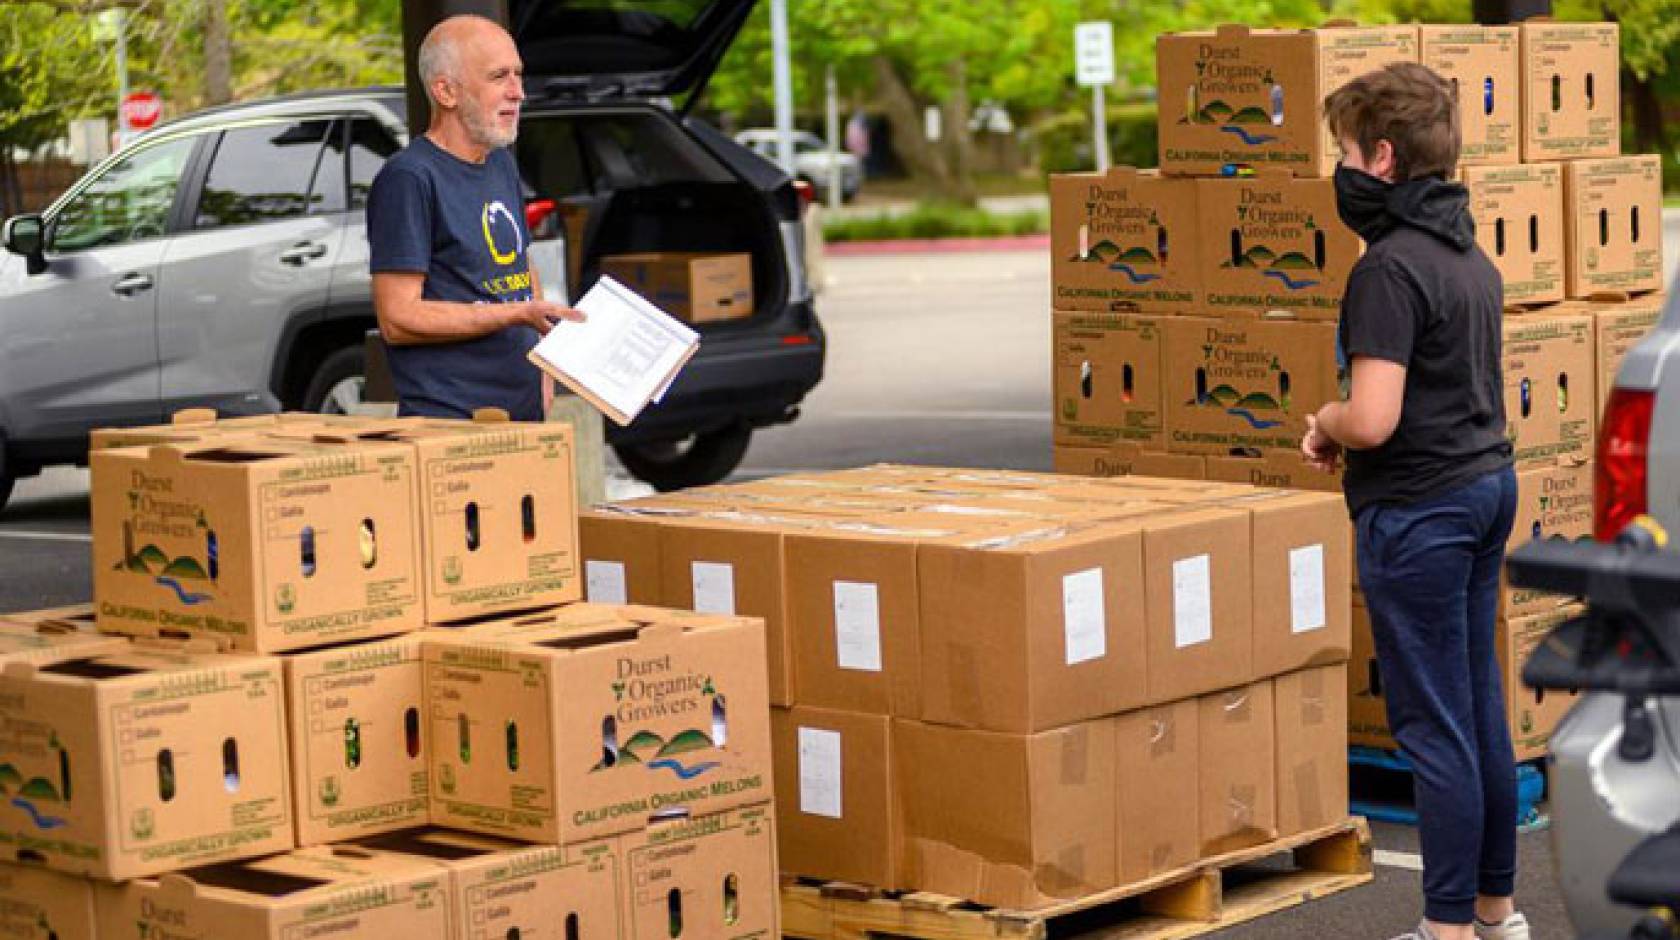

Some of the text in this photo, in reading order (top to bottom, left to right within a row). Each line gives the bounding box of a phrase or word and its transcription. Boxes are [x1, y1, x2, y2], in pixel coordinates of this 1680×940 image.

[1200, 43, 1240, 60] Durst
[1207, 60, 1262, 80] Organic
[1200, 78, 1261, 94] Growers
[1089, 185, 1128, 201] Durst
[1241, 188, 1282, 204] Durst
[1097, 202, 1150, 220] Organic
[1250, 206, 1305, 223] Organic
[1089, 218, 1144, 234] Growers
[1241, 223, 1302, 239] Growers
[1206, 328, 1247, 343] Durst
[1214, 345, 1269, 363] Organic
[1206, 362, 1267, 378] Growers
[1094, 458, 1133, 476] Durst
[132, 470, 173, 493] Durst
[1251, 469, 1291, 486] Durst
[1542, 476, 1577, 493] Durst
[140, 495, 198, 518] Organic
[1551, 494, 1593, 511] Organi
[132, 514, 194, 537] Growers
[101, 601, 248, 634] CALIFORNIA ORGANIC MELONS
[284, 605, 403, 634] ORGANICALLY GROWN
[616, 654, 671, 679] Durst
[628, 670, 702, 702] Organic
[616, 697, 698, 723] Growers
[572, 799, 648, 826] CALIFORNIA
[651, 786, 709, 808] ORGANIC
[710, 774, 762, 795] MELONS
[141, 897, 187, 926] Durst
